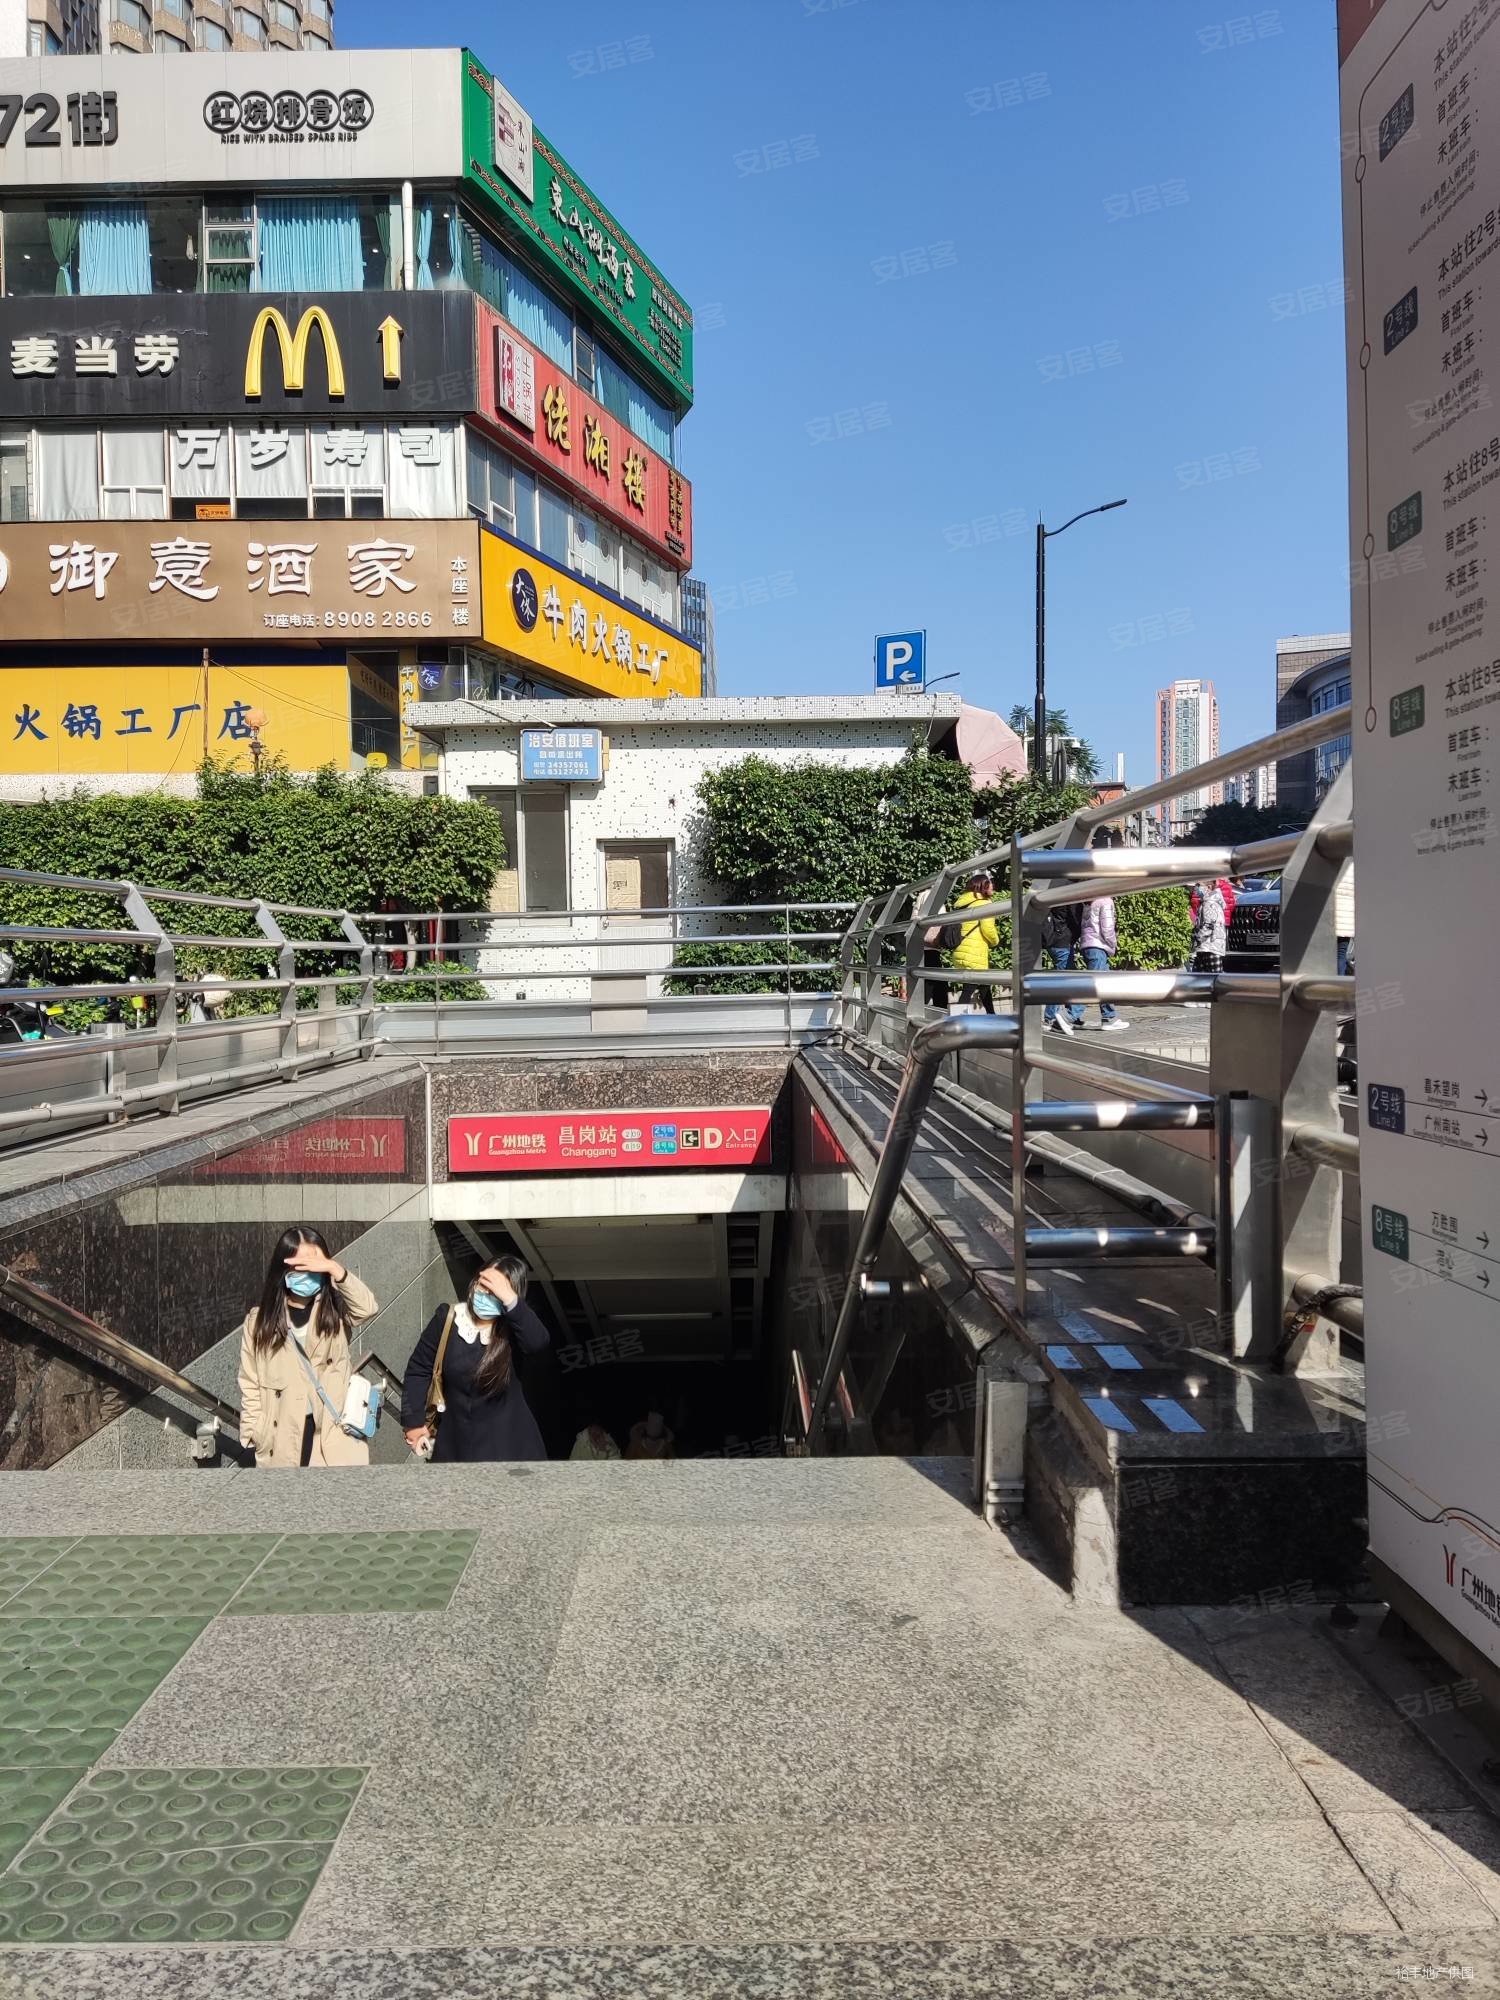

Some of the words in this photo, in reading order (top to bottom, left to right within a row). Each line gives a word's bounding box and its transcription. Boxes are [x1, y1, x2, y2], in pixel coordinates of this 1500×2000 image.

[207, 92, 371, 130] 红烧排骨饭
[221, 134, 241, 145] RICE
[243, 134, 266, 145] WITH
[268, 133, 305, 144] BRAISED
[308, 132, 336, 143] SPARE
[338, 132, 358, 143] RIBS
[1438, 206, 1500, 281] 本站往2号
[11, 334, 179, 377] 麦当劳
[177, 428, 442, 470] 万岁寿司
[49, 536, 418, 600] 御意酒家
[451, 556, 469, 626] 本座一楼
[324, 611, 375, 628] 8908
[381, 611, 432, 628] 2866
[541, 584, 669, 685] 牛肉火锅工厂
[886, 641, 913, 681] P
[13, 699, 252, 742] 火锅工厂店
[529, 733, 593, 748] 治安值班室
[1371, 1086, 1401, 1115] 2号线
[488, 1133, 547, 1149] 广州地铁
[558, 1124, 618, 1145] 昌岗站
[704, 1127, 723, 1149] D
[726, 1127, 757, 1142] 入口
[526, 1147, 547, 1155] Metro
[561, 1147, 617, 1158] Changgang
[1375, 1208, 1405, 1241] 8号线
